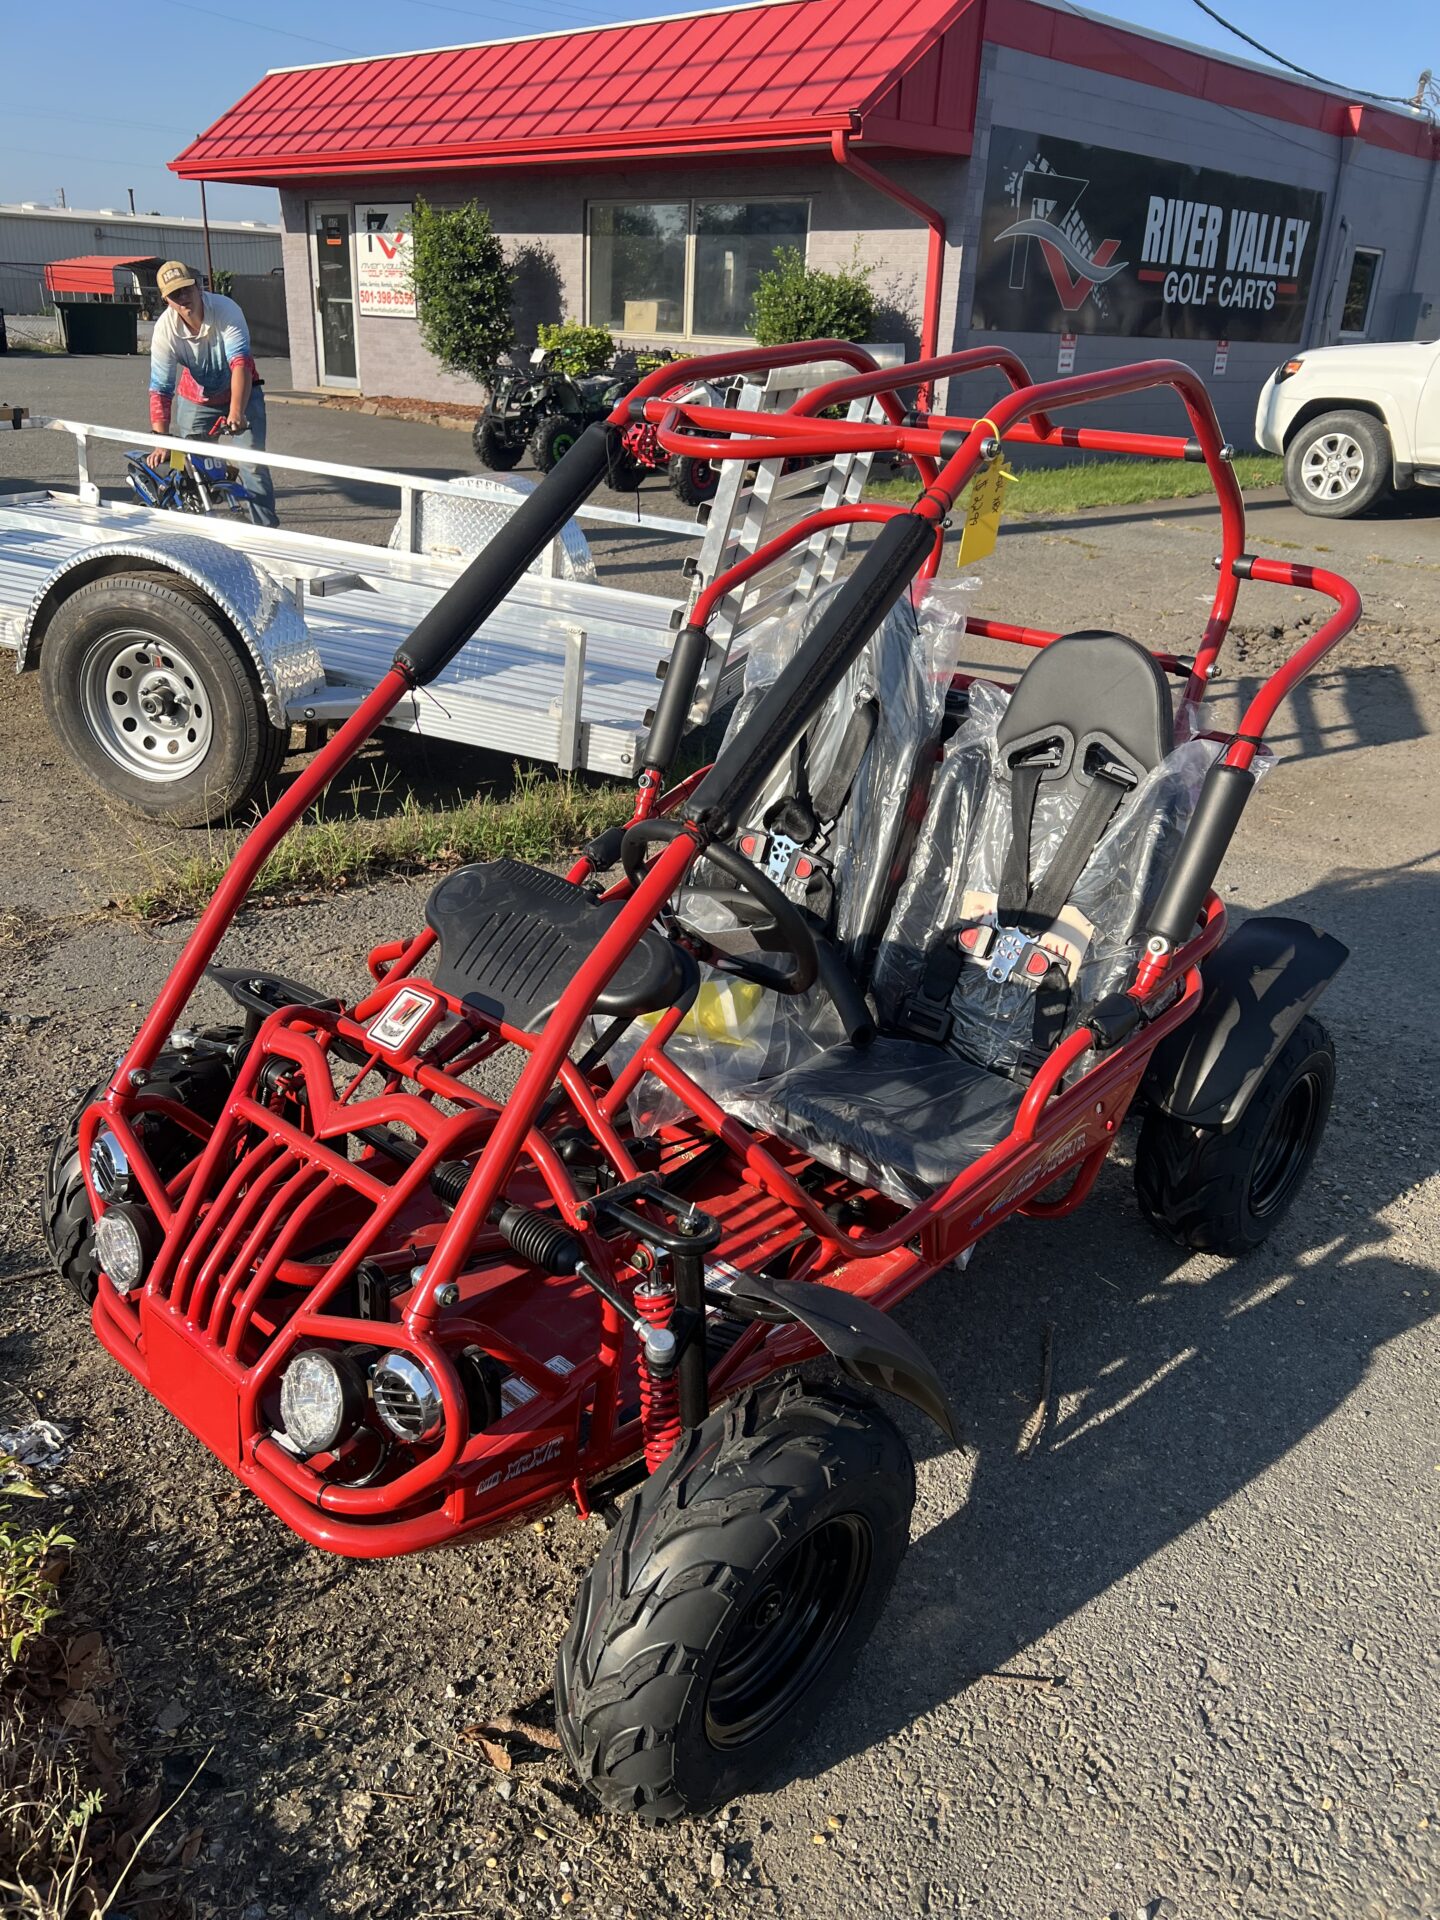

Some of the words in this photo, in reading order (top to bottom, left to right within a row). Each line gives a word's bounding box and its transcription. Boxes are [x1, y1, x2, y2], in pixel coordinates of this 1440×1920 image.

[1141, 195, 1223, 269] RIVER
[1225, 208, 1311, 278] VALLEY
[1163, 270, 1216, 305] GOLF
[1218, 276, 1278, 310] CARTS
